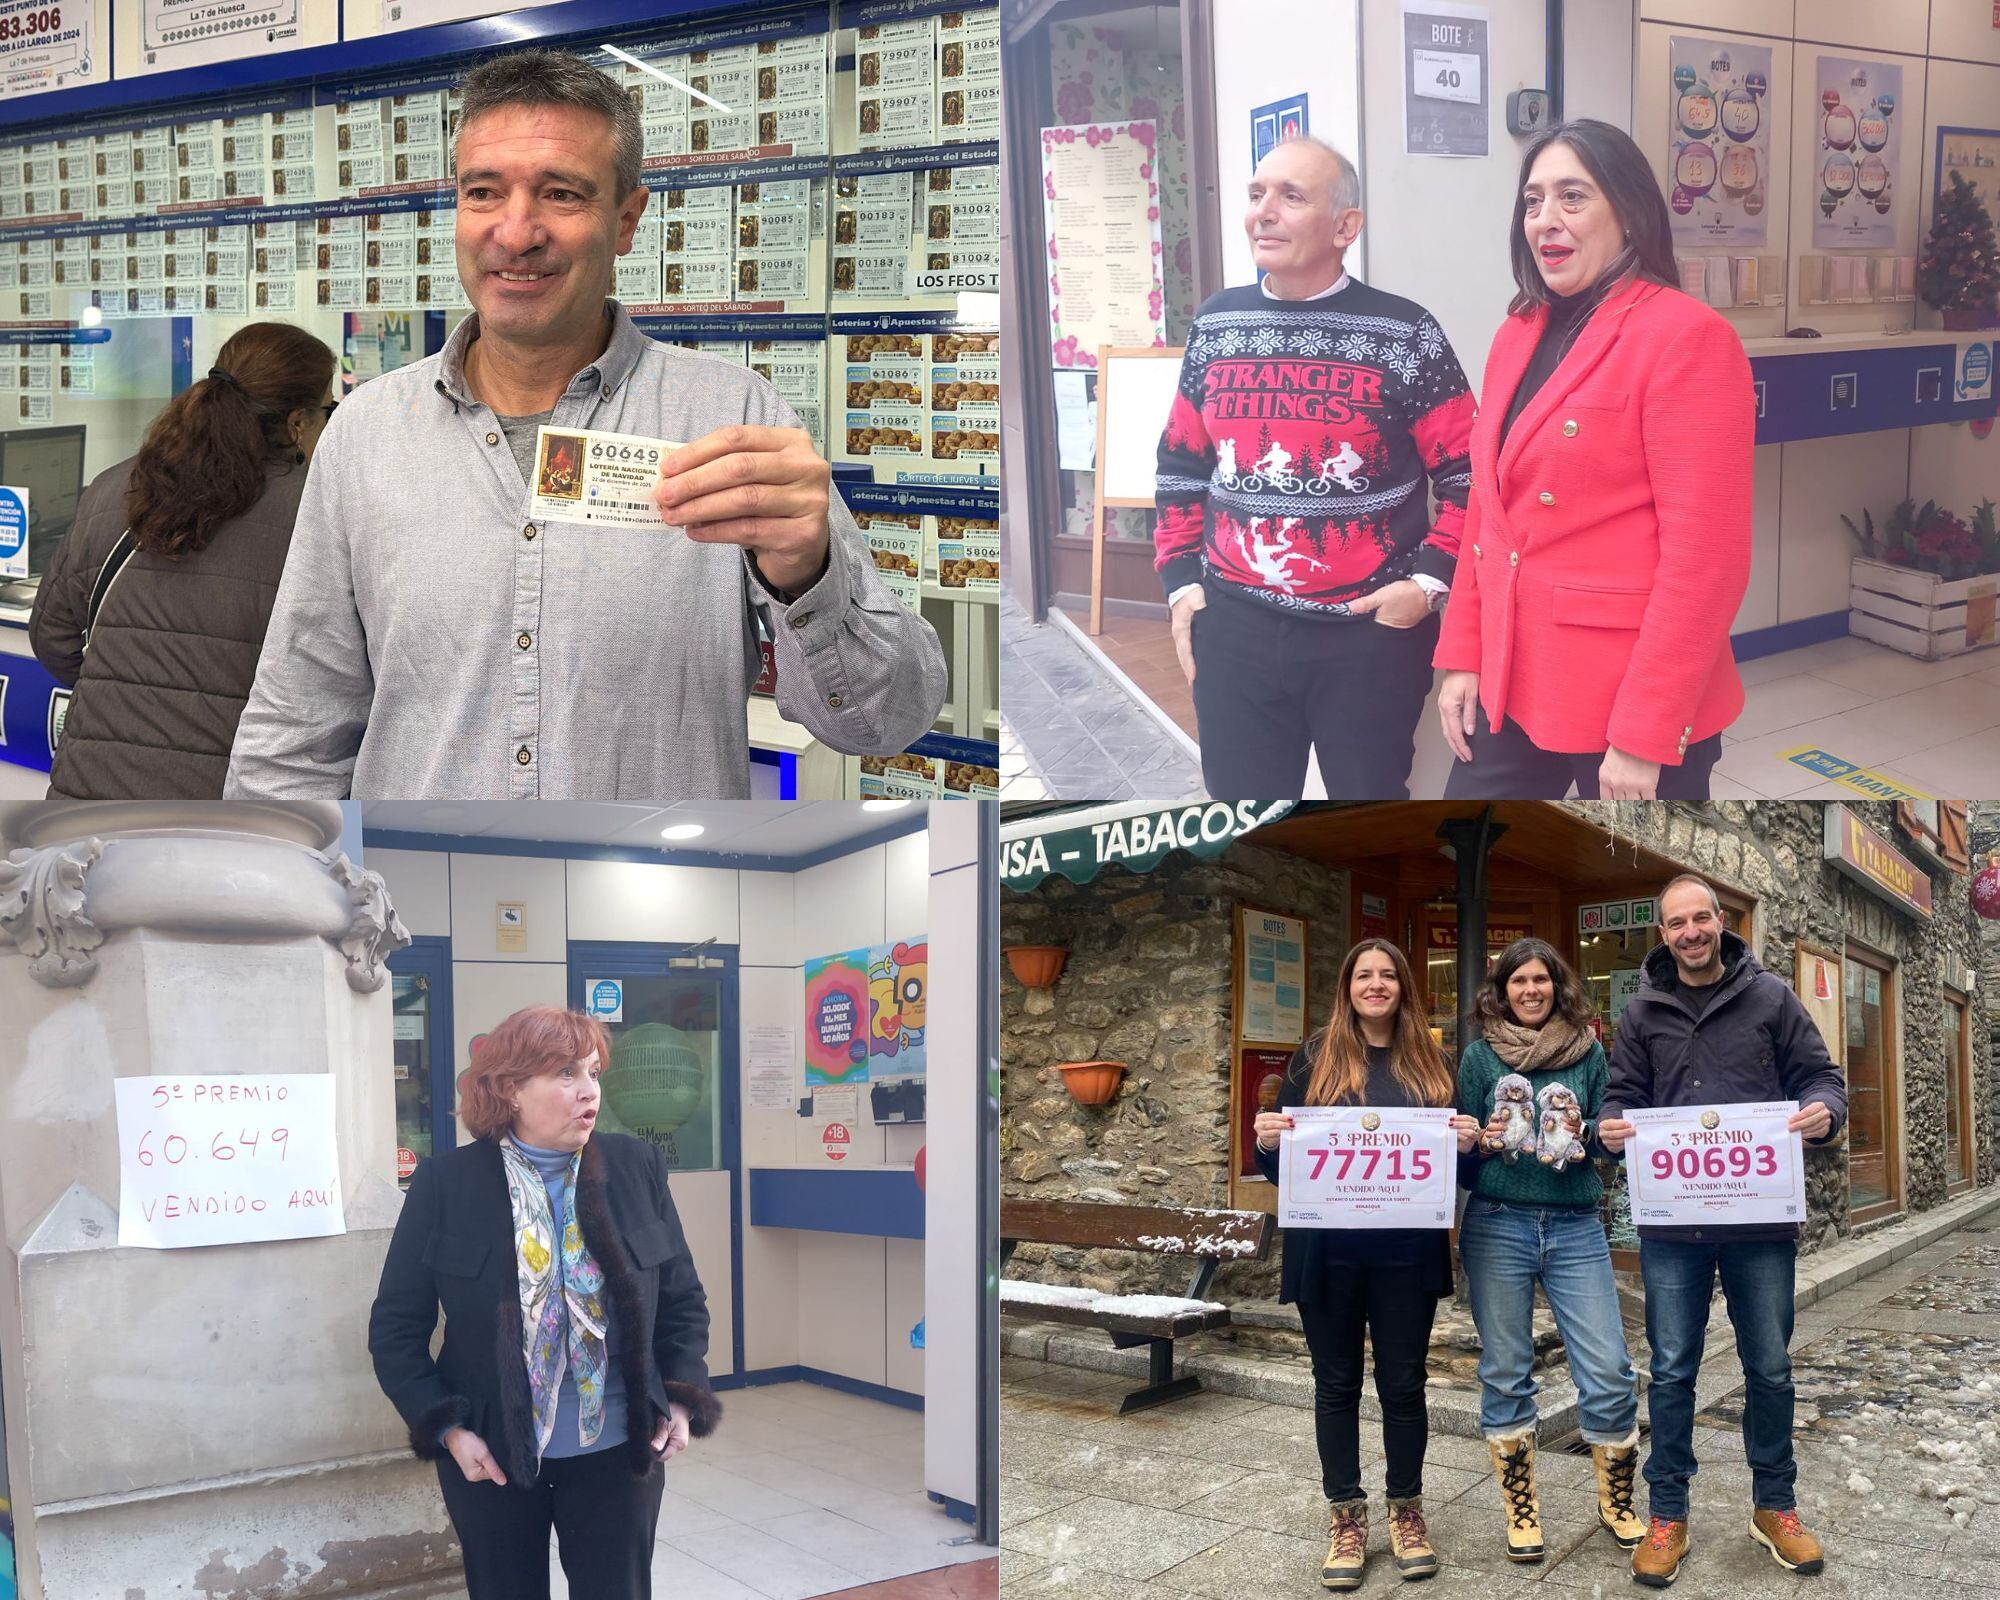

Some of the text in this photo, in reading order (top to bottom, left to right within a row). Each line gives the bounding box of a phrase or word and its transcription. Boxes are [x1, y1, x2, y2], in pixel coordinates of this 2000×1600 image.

[16, 0, 38, 11] PUNTO
[190, 2, 246, 21] La 7 de Huesca
[0, 7, 61, 41] 83.306
[705, 20, 792, 40] Apuestas del Estado
[1431, 24, 1462, 44] BOTE
[17, 41, 26, 49] LO
[27, 36, 52, 47] LARGO
[53, 33, 62, 42] DE
[62, 29, 80, 39] 2024
[883, 50, 917, 60] 79907
[779, 63, 810, 74] 52438
[1711, 61, 1730, 72] BOTES
[711, 73, 740, 84] 11939
[1435, 69, 1461, 88] 40
[883, 97, 917, 108] 79907
[779, 109, 810, 120] 52438
[711, 117, 740, 128] 11939
[646, 125, 674, 135] 22190
[641, 160, 654, 168] DEL
[654, 156, 681, 166] SÁBADO
[689, 154, 716, 163] SORTEO
[717, 153, 733, 161] DEL
[835, 150, 997, 170] Loterías y Apuestas del Estado
[688, 171, 721, 181] Loterías
[723, 172, 729, 180] y
[738, 165, 779, 177] Apuestas
[781, 164, 795, 172] del
[798, 161, 828, 170] Estado
[953, 205, 991, 214] 81002
[761, 215, 794, 224] 90085
[860, 211, 895, 221] 00183
[858, 258, 893, 267] 00183
[952, 253, 990, 262] 81002
[685, 265, 716, 273] 98359
[760, 260, 793, 269] 90085
[917, 275, 944, 288] LOS
[948, 274, 985, 287] FEOS
[647, 303, 674, 312] SÁBADO
[683, 304, 709, 312] SORTEO
[724, 302, 753, 311] SÁBADO
[661, 323, 672, 331] del
[673, 323, 698, 331] Estado
[700, 322, 730, 331] Loterías
[745, 323, 782, 332] Apuestas
[782, 322, 794, 330] del
[796, 322, 823, 330] Estado
[832, 317, 956, 328] Loterías y Apuestas del
[773, 365, 806, 374] 32611
[873, 370, 909, 379] 61086
[959, 371, 997, 380] 81222
[1204, 365, 1383, 402] STRANGER
[1214, 392, 1351, 423] THINGS
[873, 416, 909, 426] 61086
[959, 419, 997, 428] 81222
[592, 444, 659, 462] 60649
[590, 463, 657, 475] LOTERÍA NACIONAL
[606, 478, 631, 486] diciembre
[612, 472, 644, 481] NAVIDAD
[899, 474, 979, 485] SORTEO DEL JUEVES
[891, 494, 898, 502] y
[909, 495, 956, 506] Apuestas
[958, 498, 974, 507] del
[870, 538, 906, 549] 09100
[887, 785, 922, 799] 61625
[1846, 774, 1919, 800] MANT
[1091, 800, 1256, 864] TABACOS
[1867, 842, 1914, 895] TABACOS
[1263, 919, 1286, 935] BOTES
[1487, 929, 1525, 940] ACOS
[823, 994, 849, 1004] AHORA
[824, 1013, 848, 1023] AL MES
[821, 1023, 852, 1034] DURANTE
[822, 1032, 850, 1043] 30 AÑOS
[194, 1084, 288, 1103] PREMIO
[828, 1126, 844, 1139] +18
[1688, 1130, 1753, 1146] PREMIO
[1347, 1133, 1412, 1147] PREMIO
[138, 1128, 289, 1167] 60.649
[1307, 1149, 1432, 1181] 77715
[1651, 1145, 1778, 1180] 90693
[1335, 1186, 1375, 1194] VENDIDO
[1683, 1182, 1722, 1191] VENDIDO
[141, 1177, 336, 1223] VENDIDO AQUÍ
